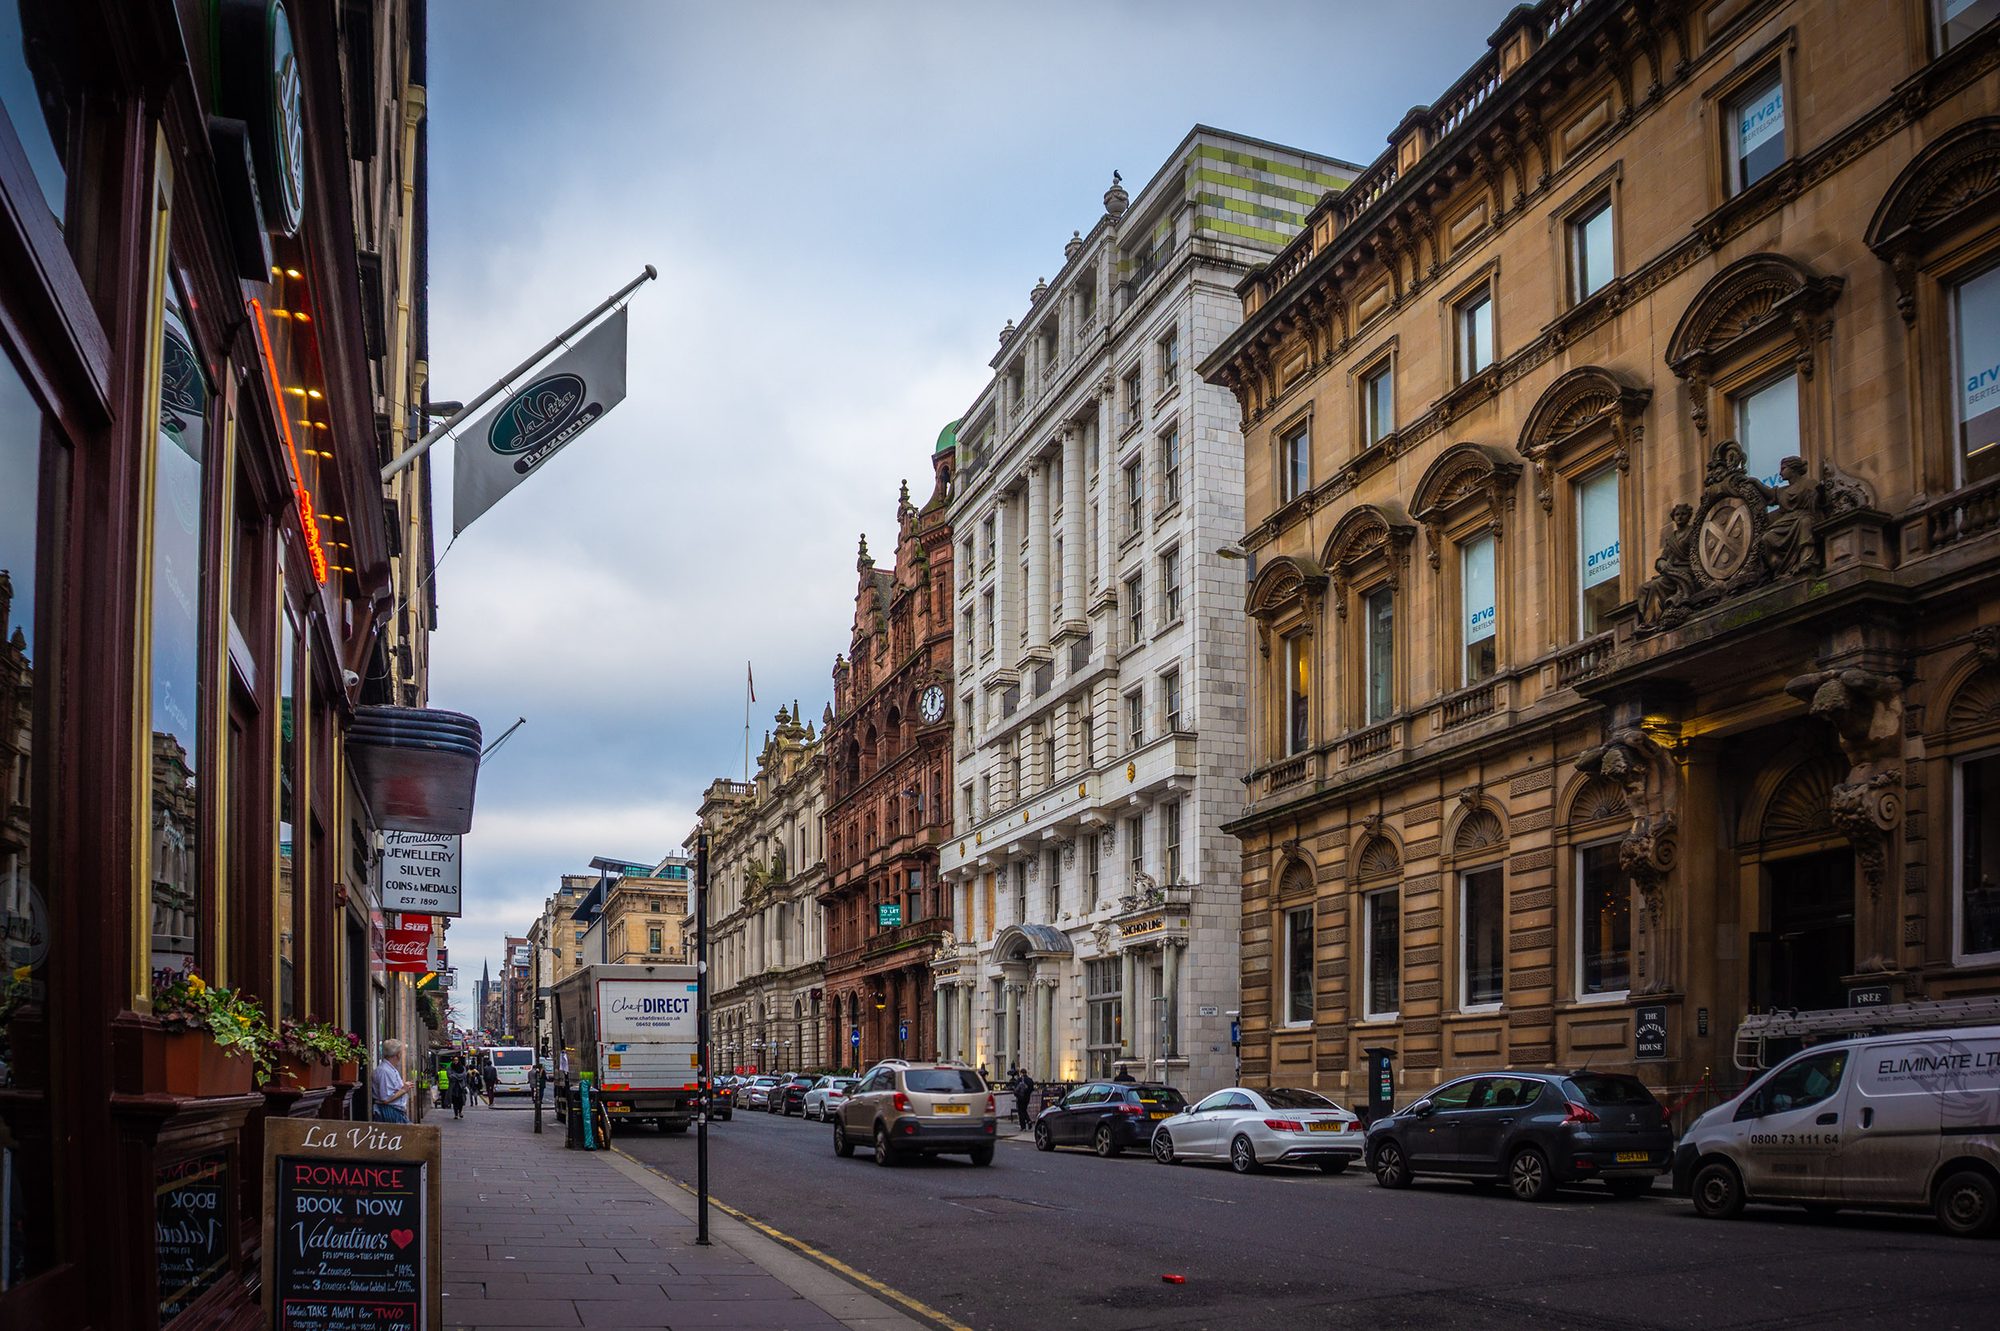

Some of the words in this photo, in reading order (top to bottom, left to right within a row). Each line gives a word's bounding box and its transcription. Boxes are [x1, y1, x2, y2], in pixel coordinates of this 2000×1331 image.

[520, 388, 576, 428] Vita
[521, 411, 596, 469] Pizzeria
[387, 848, 455, 862] JEWELLERY
[400, 865, 441, 877] SILVER
[385, 880, 413, 891] COINS
[414, 884, 419, 892] &
[420, 883, 457, 895] MEDALS
[400, 897, 416, 905] EST.
[420, 897, 438, 906] 1890
[1857, 993, 1882, 1004] FREE
[1644, 1012, 1658, 1020] THE
[1635, 1023, 1667, 1038] COUNTING
[1640, 1043, 1662, 1051] HOUSE
[1878, 1053, 1972, 1074] ELIMINATE
[301, 1125, 338, 1148] La
[346, 1125, 403, 1151] Vita
[1751, 1134, 1778, 1144] 0800
[1781, 1134, 1795, 1145] 73
[1799, 1134, 1819, 1145] 111
[1824, 1134, 1839, 1145] 64
[295, 1165, 404, 1188] ROMANCE
[296, 1196, 343, 1215] BOOK
[356, 1198, 403, 1216] NOW
[318, 1262, 327, 1276] 2
[312, 1279, 321, 1291] 3
[307, 1305, 328, 1318] TAKE
[331, 1306, 355, 1319] AWAY
[374, 1307, 404, 1320] TWO
